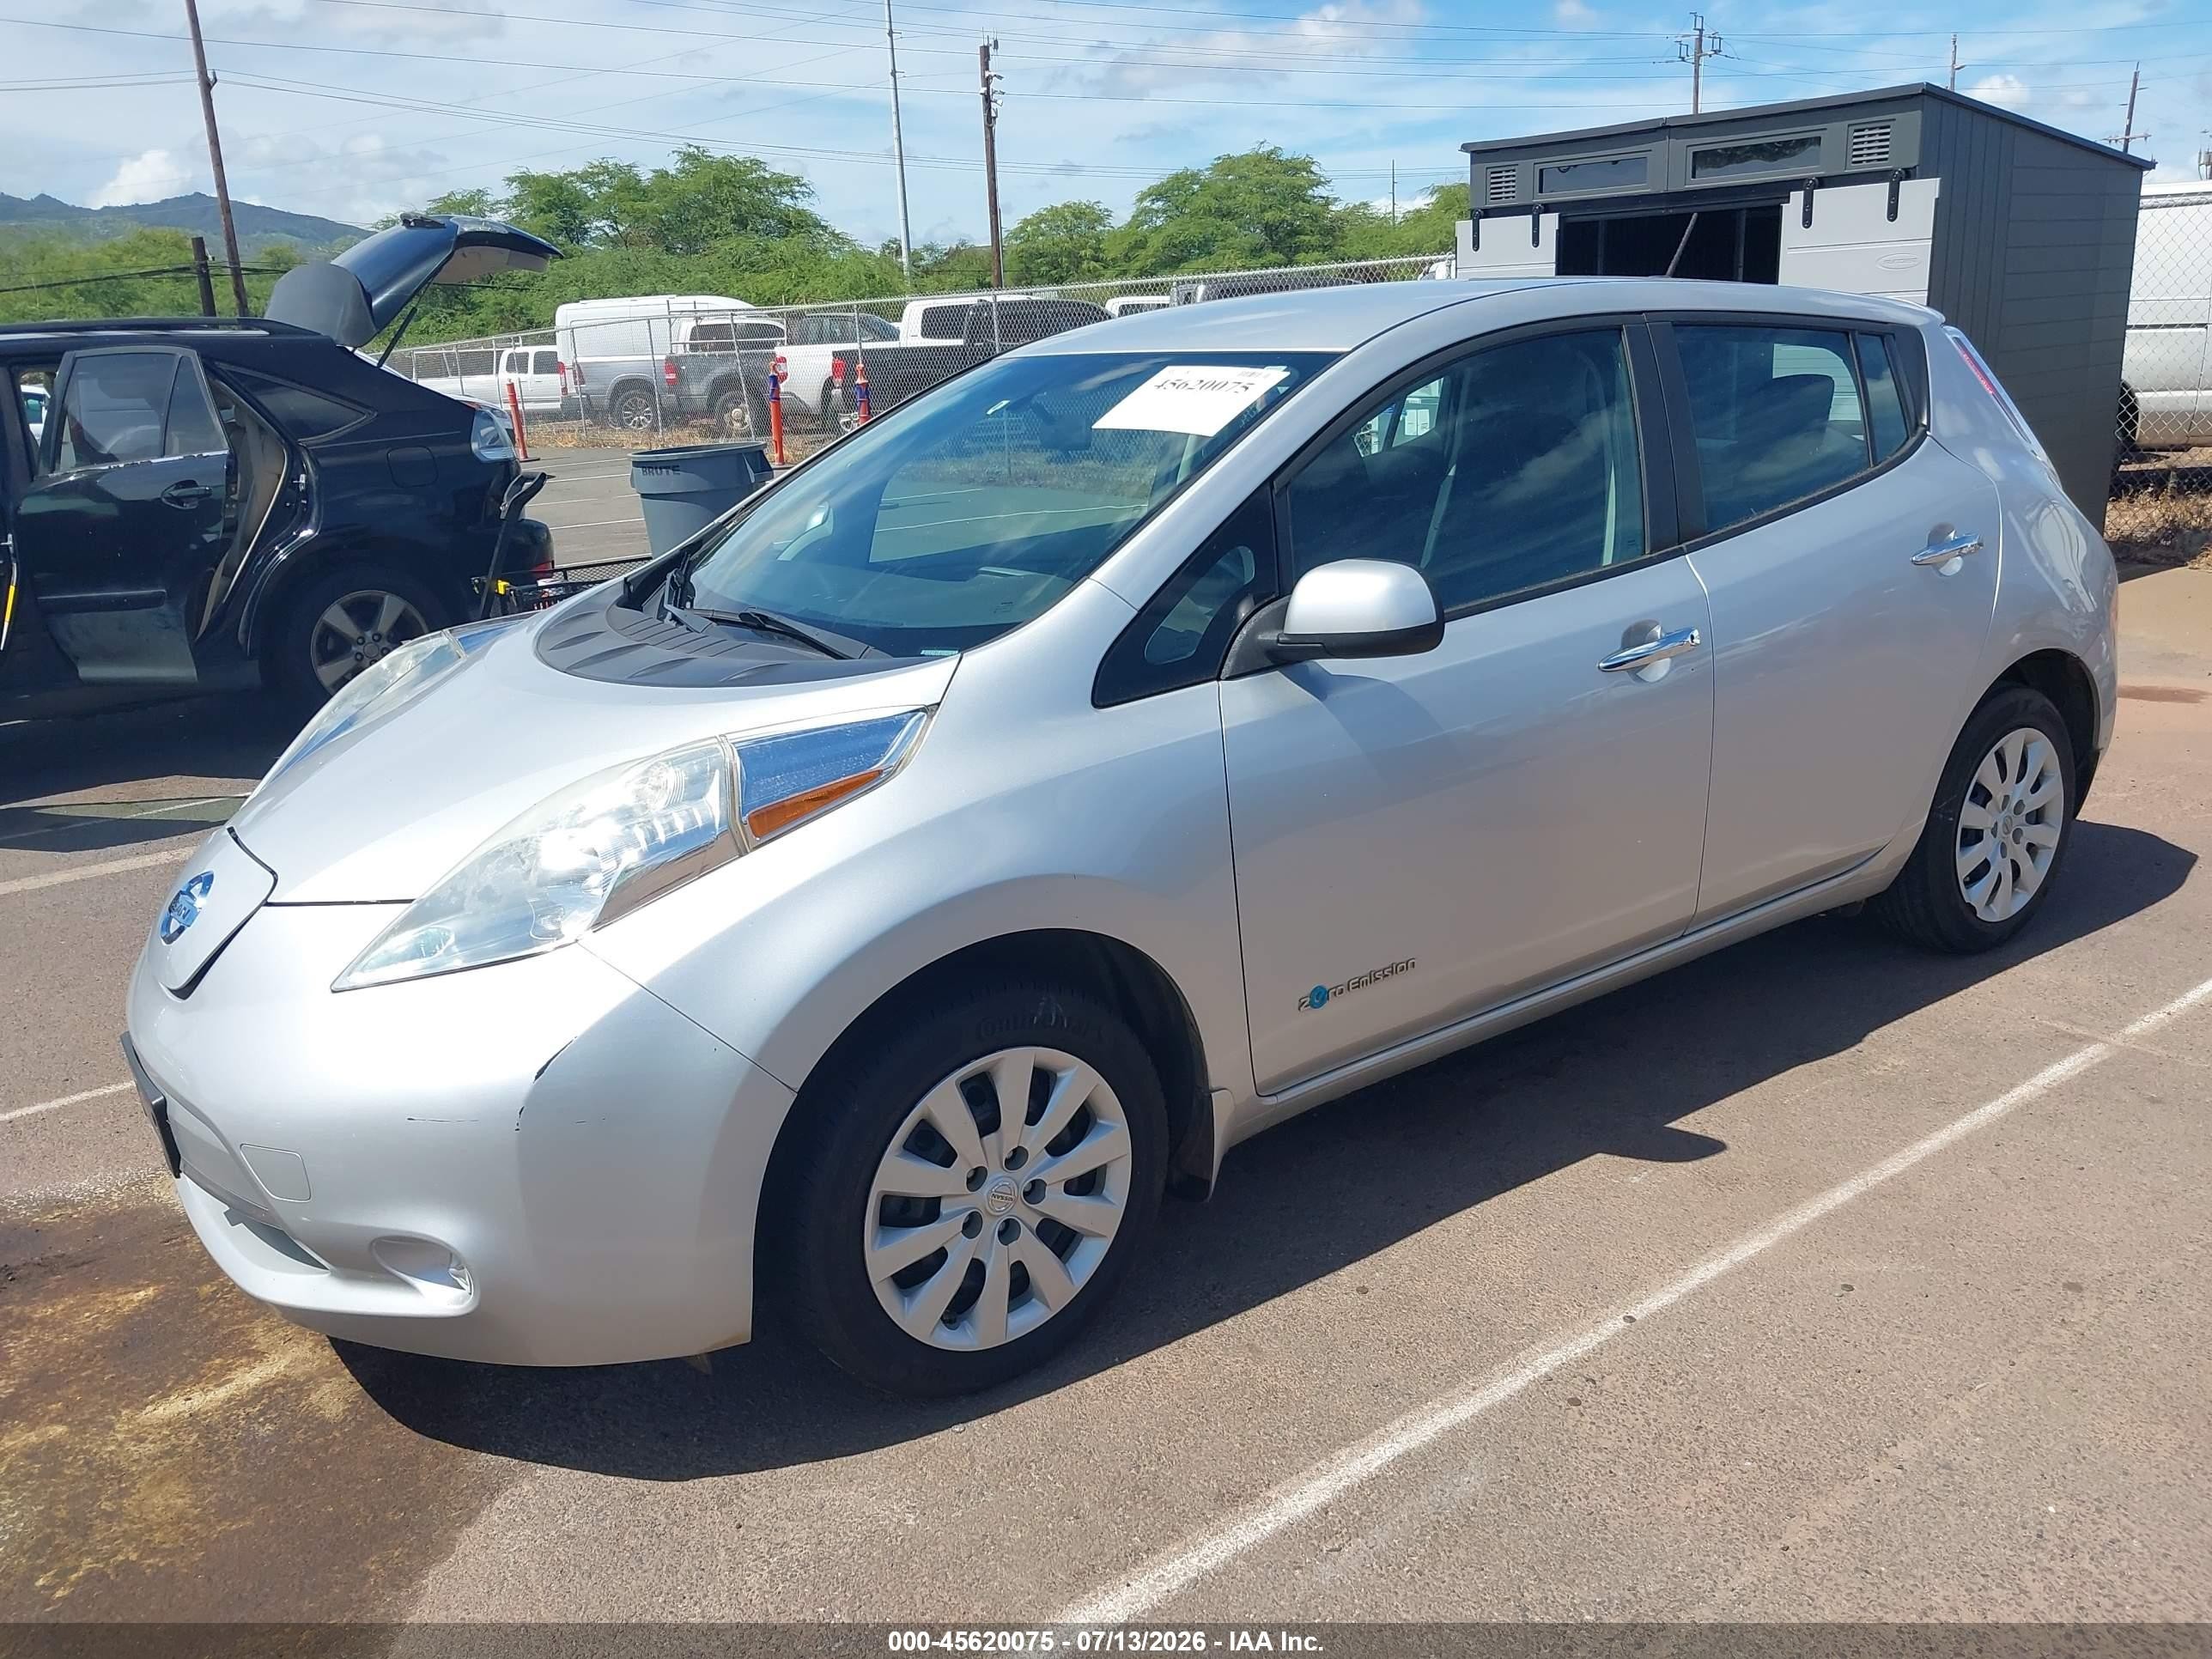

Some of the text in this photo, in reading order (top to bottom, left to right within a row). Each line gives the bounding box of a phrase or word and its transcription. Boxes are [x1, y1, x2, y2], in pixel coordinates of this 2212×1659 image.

[1153, 379, 1255, 394] 45620075
[641, 465, 681, 476] BRUTE
[1347, 957, 1416, 993] Emission
